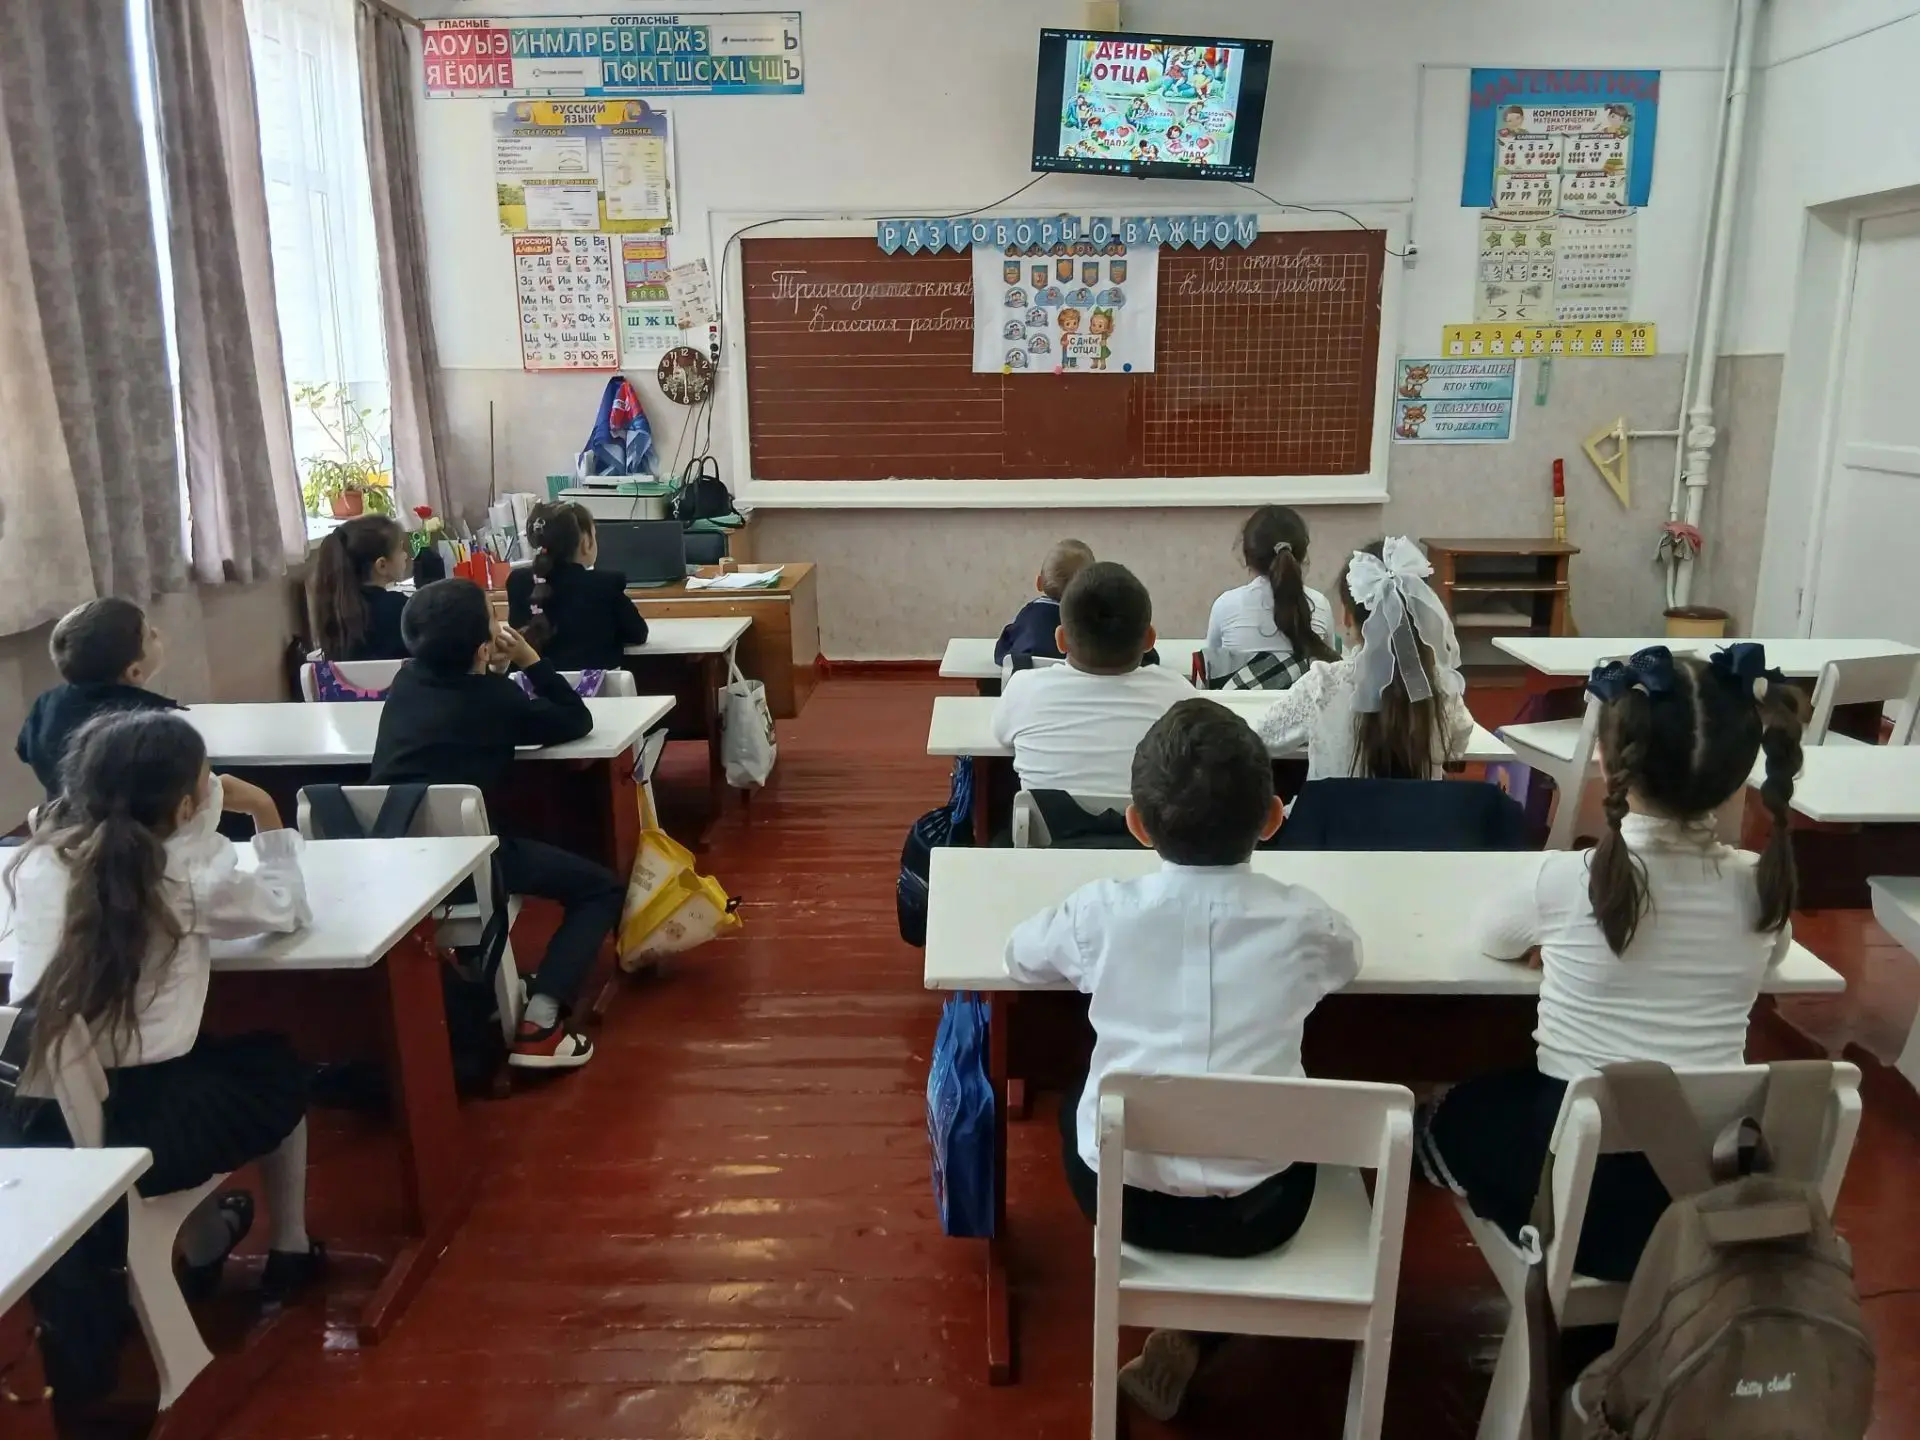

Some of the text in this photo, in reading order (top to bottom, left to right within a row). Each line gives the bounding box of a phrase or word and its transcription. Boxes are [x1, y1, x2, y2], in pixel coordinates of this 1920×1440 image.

[438, 20, 490, 28] ГЛАСНЫЕ
[610, 16, 679, 25] СОГЛАСНЫЕ
[784, 30, 798, 50] Ь
[1095, 42, 1153, 61] ДЕНЬ
[1094, 64, 1150, 84] ОТЦА
[552, 102, 606, 114] РУССКИЙ
[1533, 109, 1597, 117] КОМПОНЕНТЫ
[564, 114, 596, 124] ЯЗЫК
[612, 128, 652, 136] ФОНЕТИКА
[1546, 124, 1581, 132] ДЕЙСТВИЙ
[885, 218, 1253, 247] РАЗГОВОРЫ О ВАЖНОМ
[515, 237, 551, 245] РУССКИЙ
[574, 237, 587, 246] Бб
[1208, 256, 1225, 270] 13
[628, 316, 677, 327] Ш Ж Ц
[808, 304, 900, 332] Классная
[1455, 329, 1645, 339] 1 2 3 4 5 6 7 8 9 10
[681, 348, 688, 356] 12
[1073, 346, 1097, 354] ОТЦА!
[702, 360, 708, 368] 2
[1430, 364, 1514, 376] ПОДЛЕЖАЩЕЕ
[1443, 383, 1467, 391] КТО?
[683, 396, 689, 404] 6
[1434, 403, 1504, 412] СКАЗУЕМОЕ
[1454, 423, 1499, 431] ДЕЛАЕТ?
